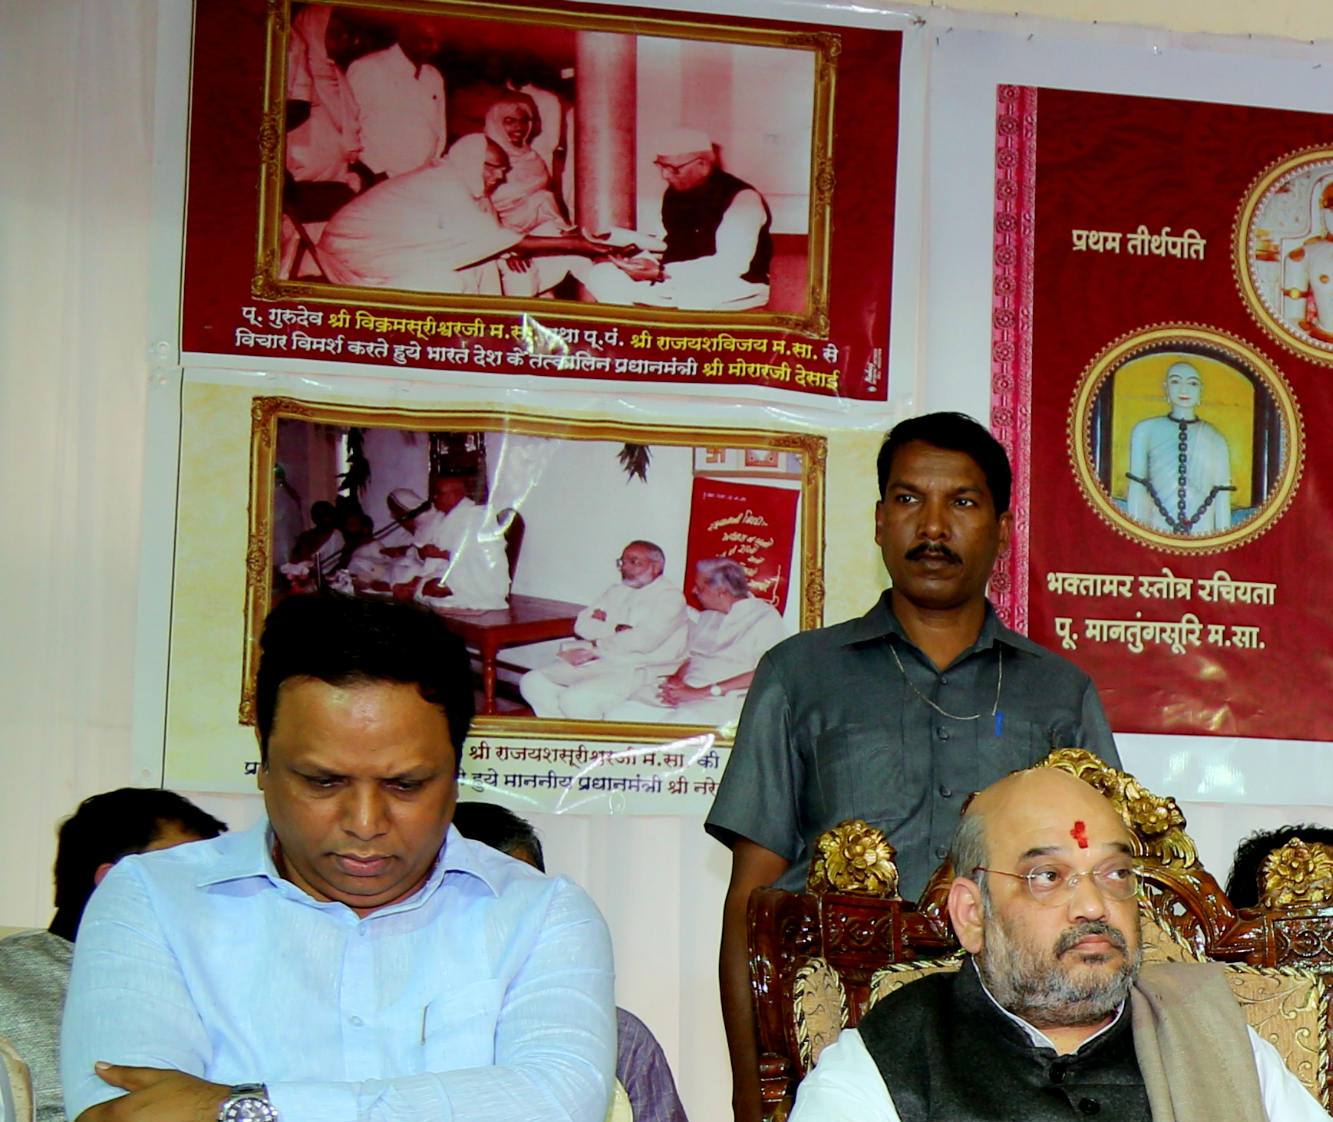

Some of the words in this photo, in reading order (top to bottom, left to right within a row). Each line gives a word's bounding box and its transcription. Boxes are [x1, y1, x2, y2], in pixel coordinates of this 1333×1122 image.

[1072, 226, 1121, 254] प्रथम
[1126, 227, 1205, 260] तीर्थपति
[242, 306, 262, 328] पू.
[269, 306, 323, 328] गुरुदेव
[328, 309, 351, 328] श्री
[355, 311, 485, 340] विक्रमसूरीश्वरजी
[630, 333, 652, 350] श्री
[656, 335, 768, 353] राजयशविजय
[772, 338, 818, 360] म.सा.
[823, 344, 839, 364] से
[235, 329, 286, 349] विचार
[292, 331, 345, 353] विमर्श
[348, 339, 388, 358] करते
[393, 341, 422, 364] हुये
[427, 344, 469, 364] भारत
[473, 346, 502, 366] देश
[615, 355, 698, 377] प्रधानमंत्री
[702, 361, 724, 377] श्री
[727, 358, 791, 382] मोरारजी
[795, 364, 839, 389] देसाई
[1046, 570, 1134, 598] भक्तामर
[1138, 568, 1193, 602] स्तोत्र
[1198, 575, 1277, 606] रचियता
[1055, 619, 1079, 650] पू.
[1085, 611, 1202, 655] मानतुंगसूरि
[1206, 624, 1265, 650] म.सा.
[469, 742, 490, 760] श्री
[697, 751, 719, 769] की
[504, 769, 573, 790] माननीय
[578, 771, 661, 794] प्रधानमंत्री
[667, 775, 688, 794] श्री
